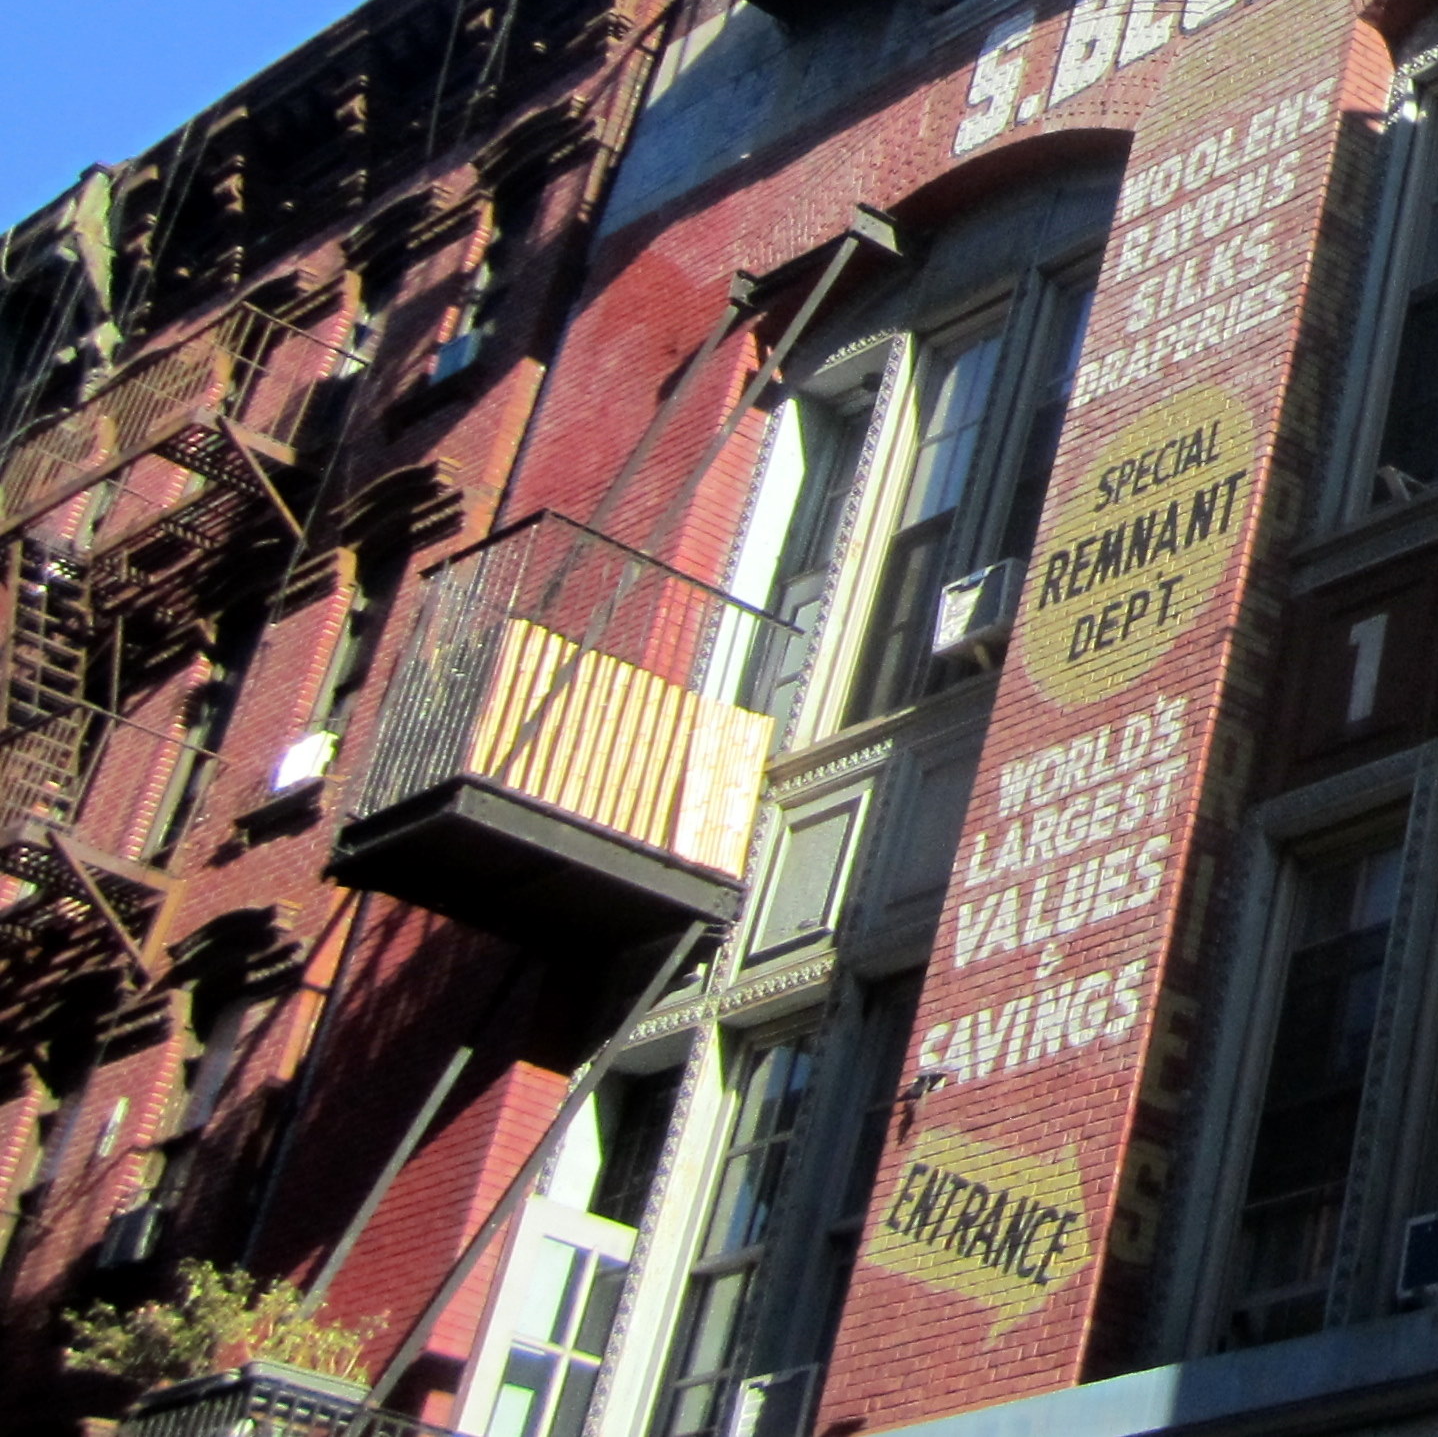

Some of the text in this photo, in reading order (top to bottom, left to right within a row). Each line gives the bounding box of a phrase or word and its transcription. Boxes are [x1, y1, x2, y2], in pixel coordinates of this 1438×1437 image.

[1116, 150, 1302, 282] RAYONS
[1121, 78, 1338, 223] WOOLENS
[1072, 271, 1294, 408] DRAPERIES
[1127, 221, 1275, 333] SILKS
[1094, 420, 1220, 512] SPECIAL
[1038, 469, 1247, 610] REMNANT
[998, 693, 1189, 817] WORLD'S
[965, 755, 1189, 888] LARGEST
[954, 834, 1172, 968] VALUES
[919, 959, 1148, 1088] SAVINGS
[885, 1162, 1078, 1289] ENTRANCE
